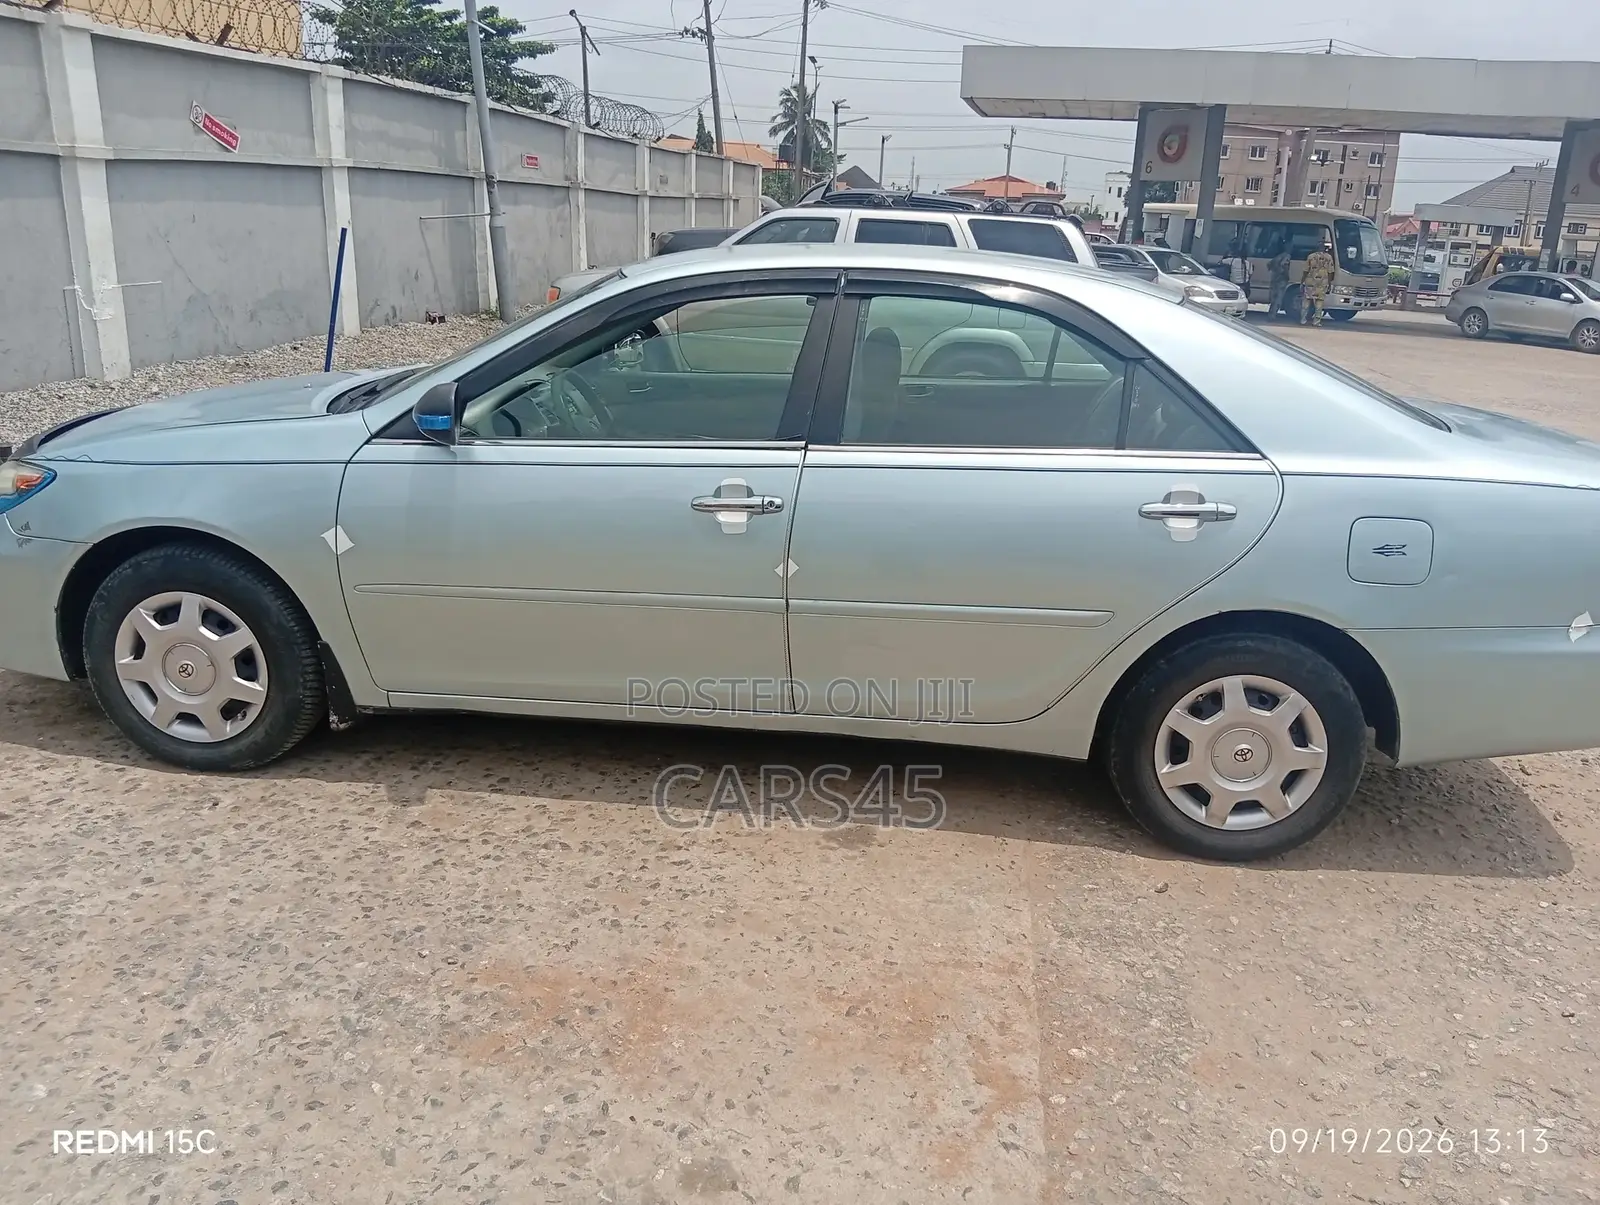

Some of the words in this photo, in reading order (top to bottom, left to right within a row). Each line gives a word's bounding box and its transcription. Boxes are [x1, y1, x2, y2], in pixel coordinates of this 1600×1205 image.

[212, 125, 237, 147] smoking
[1145, 160, 1153, 174] 6
[1570, 183, 1580, 197] 4
